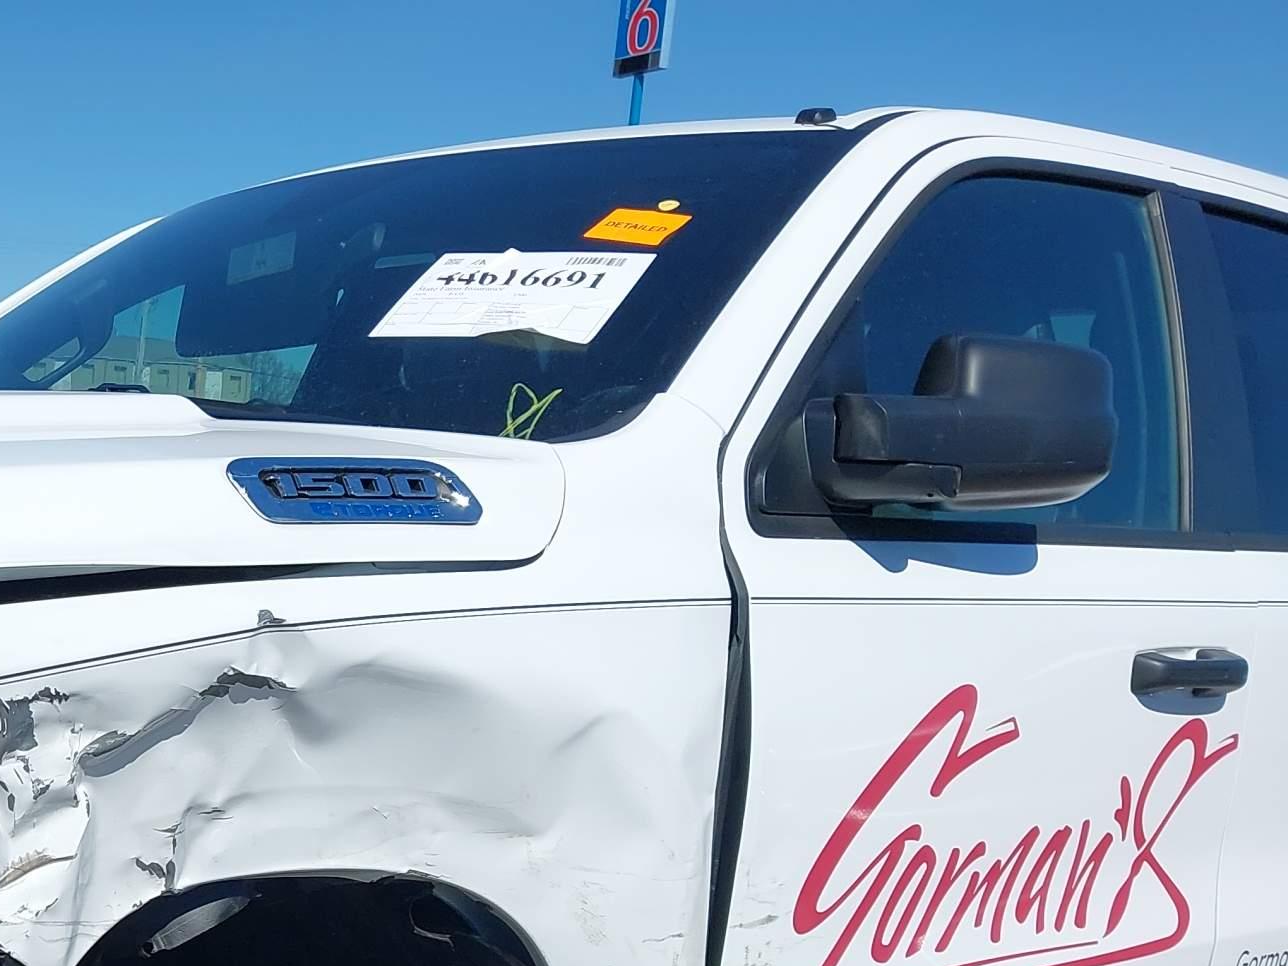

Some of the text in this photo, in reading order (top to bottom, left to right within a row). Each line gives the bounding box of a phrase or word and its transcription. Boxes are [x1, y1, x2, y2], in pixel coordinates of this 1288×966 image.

[627, 0, 660, 56] 6
[605, 221, 669, 232] DETAILED
[260, 472, 438, 498] 1500
